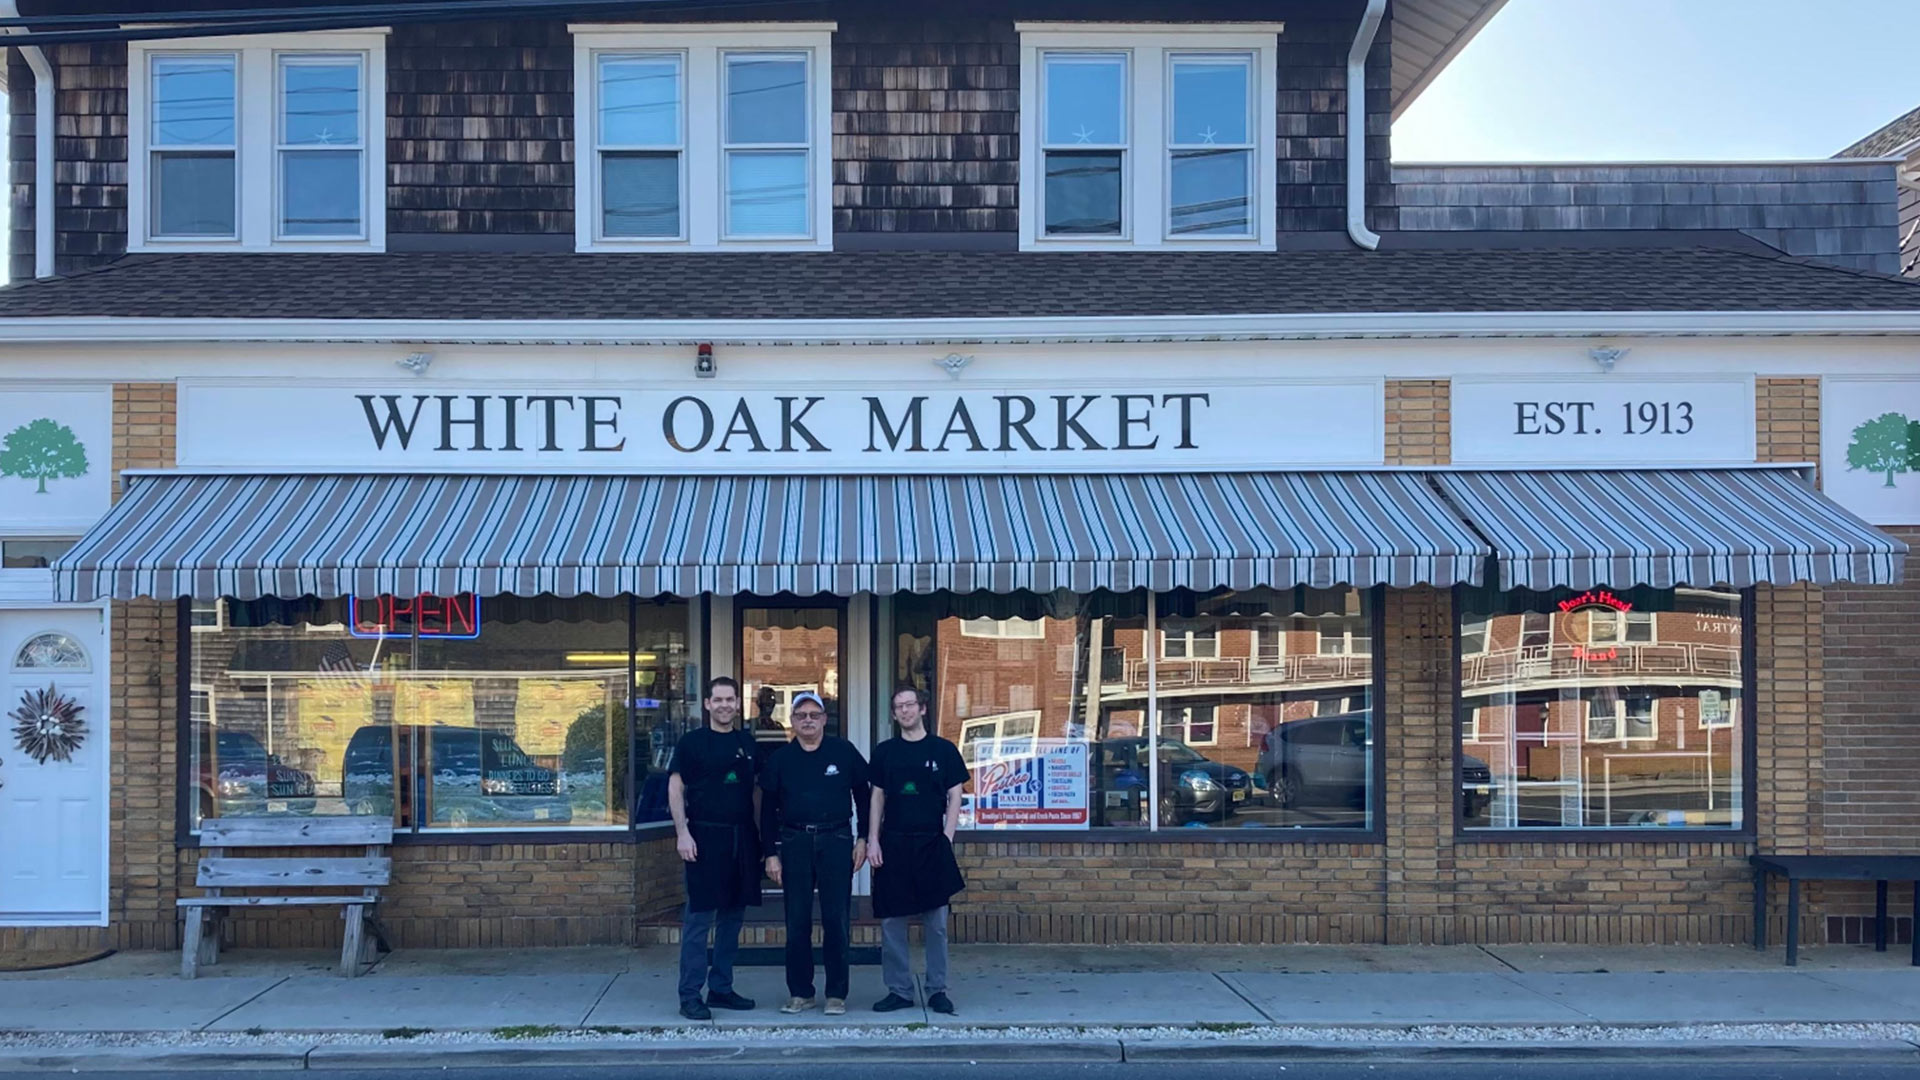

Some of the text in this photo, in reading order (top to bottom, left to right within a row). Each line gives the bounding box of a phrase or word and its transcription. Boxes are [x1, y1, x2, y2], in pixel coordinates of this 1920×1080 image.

[355, 394, 1210, 452] WHITE OAK MARKET
[1514, 401, 1694, 435] EST. 1913
[354, 591, 475, 633] OPEN
[1558, 590, 1632, 613] Boar's Head
[1572, 646, 1617, 661] Brand
[1050, 746, 1068, 755] LINE
[1070, 746, 1080, 755] OF
